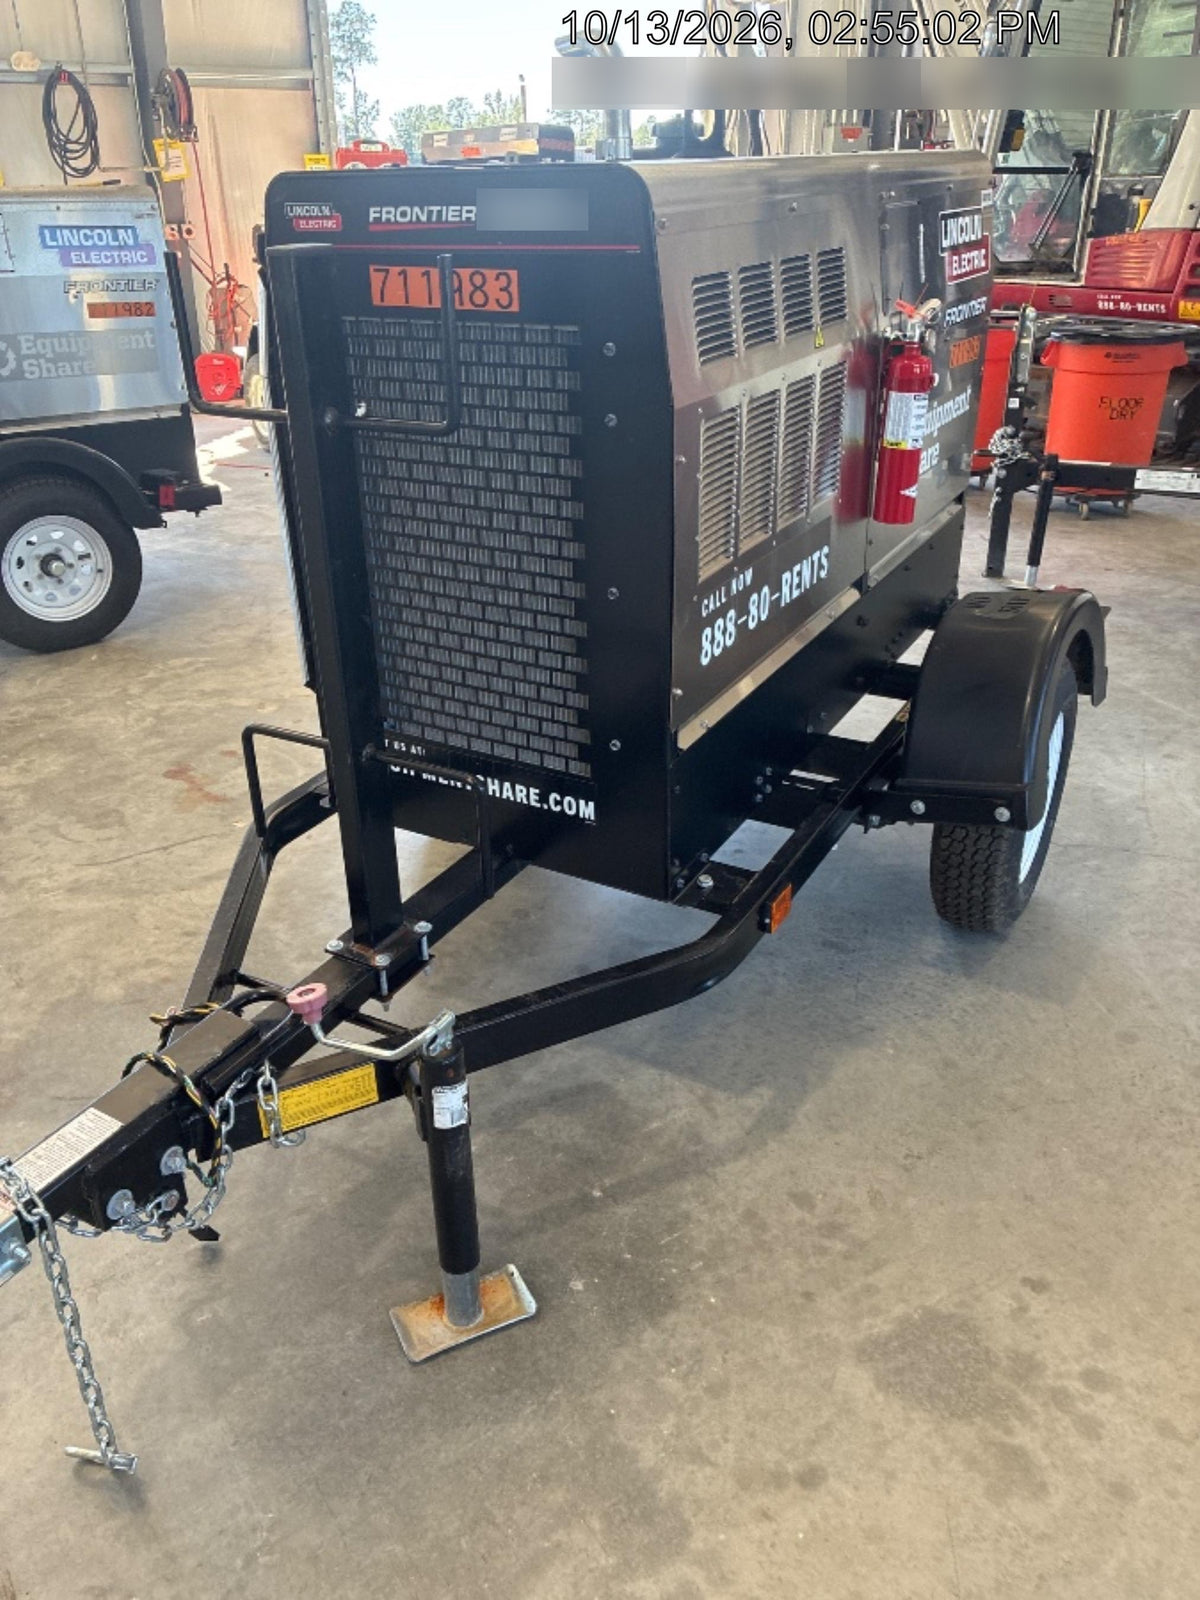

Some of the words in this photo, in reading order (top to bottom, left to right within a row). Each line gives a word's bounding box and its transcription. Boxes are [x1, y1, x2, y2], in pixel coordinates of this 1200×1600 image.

[286, 205, 331, 217] LINCOLN
[368, 205, 477, 223] FRONTIER
[299, 219, 338, 229] ELECTRIC
[941, 213, 983, 248] LINCOLN
[43, 227, 135, 247] LINCOLN
[70, 249, 149, 265] ELECTRIC
[952, 248, 987, 278] ELECTRIC
[63, 278, 158, 294] FRONTIER
[17, 328, 157, 358] Equipent
[22, 357, 99, 380] Share
[1109, 407, 1138, 421] DRY
[919, 442, 940, 475] are
[701, 586, 727, 618] CALL
[730, 566, 753, 597] NOW
[700, 545, 830, 667] 888-80-RENTS
